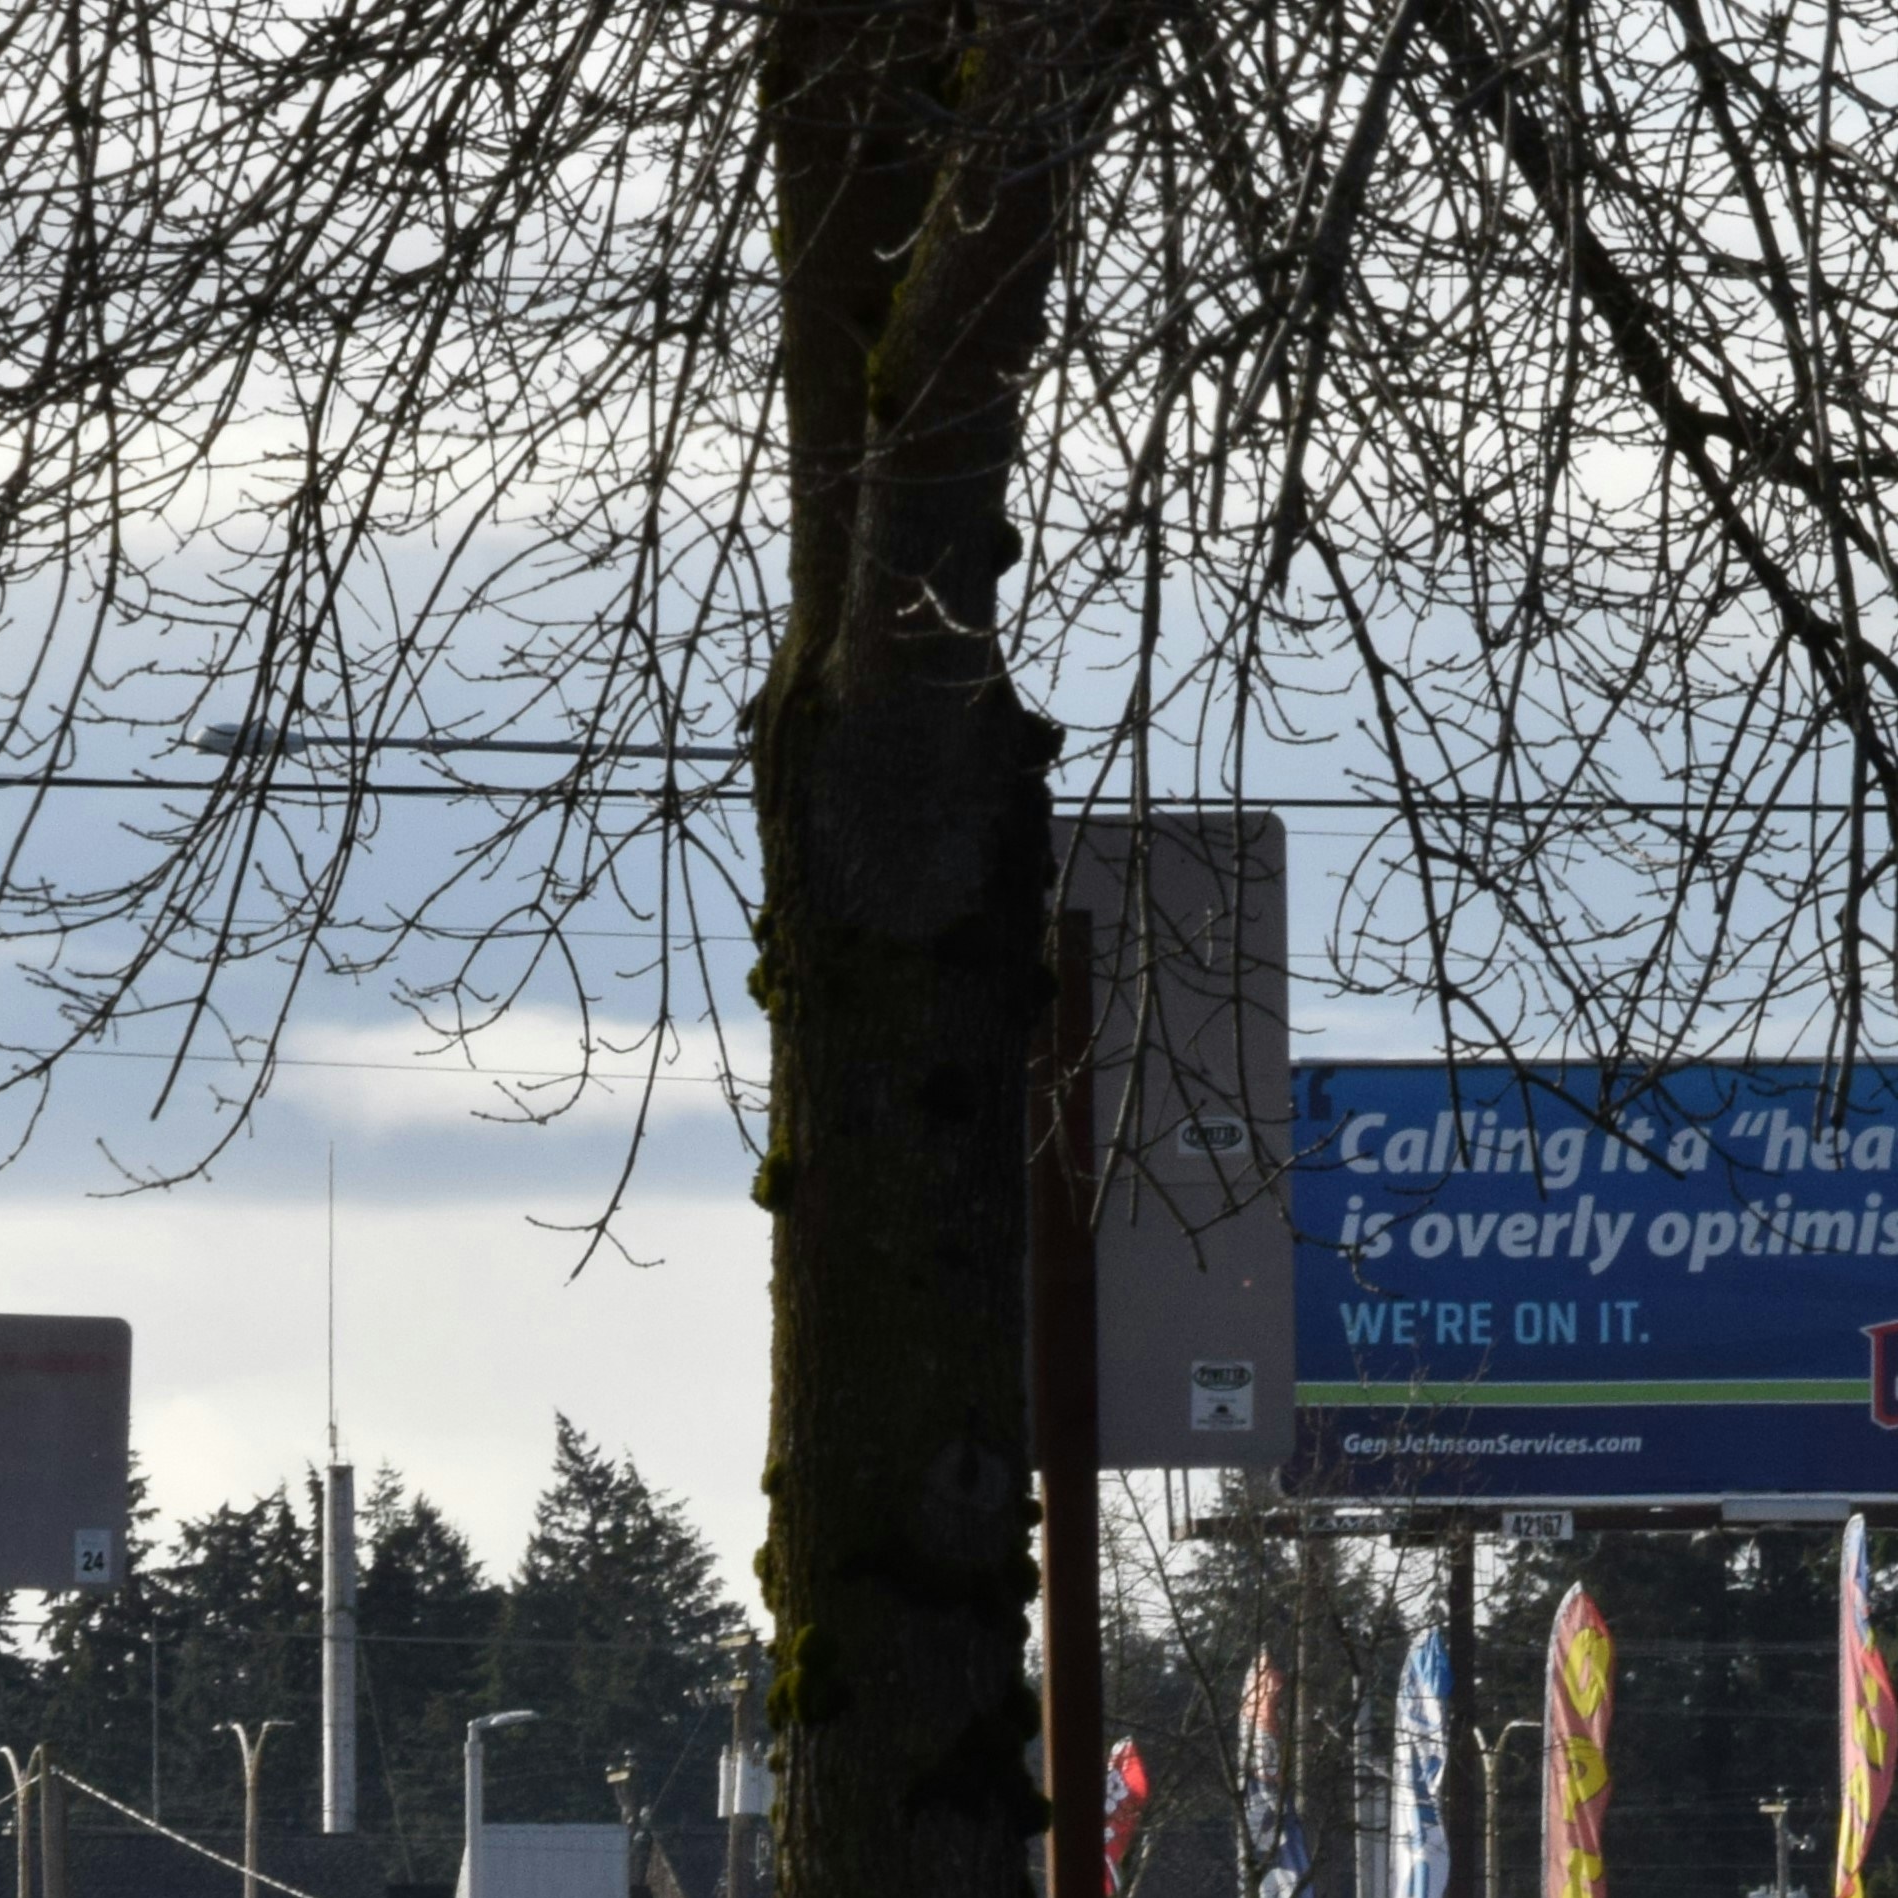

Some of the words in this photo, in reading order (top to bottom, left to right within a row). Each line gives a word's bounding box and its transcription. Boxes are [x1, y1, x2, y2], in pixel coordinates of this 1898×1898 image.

[1339, 1109, 1592, 1189] Calling
[1610, 1110, 1655, 1173] it
[1667, 1128, 1712, 1173] a
[1337, 1195, 1394, 1258] is
[1408, 1195, 1635, 1276] overly
[1339, 1301, 1494, 1345] WE'RE
[1513, 1301, 1577, 1345] ON
[1600, 1301, 1650, 1345] IT.
[1511, 1513, 1564, 1538] 42167
[83, 1551, 104, 1571] 24
